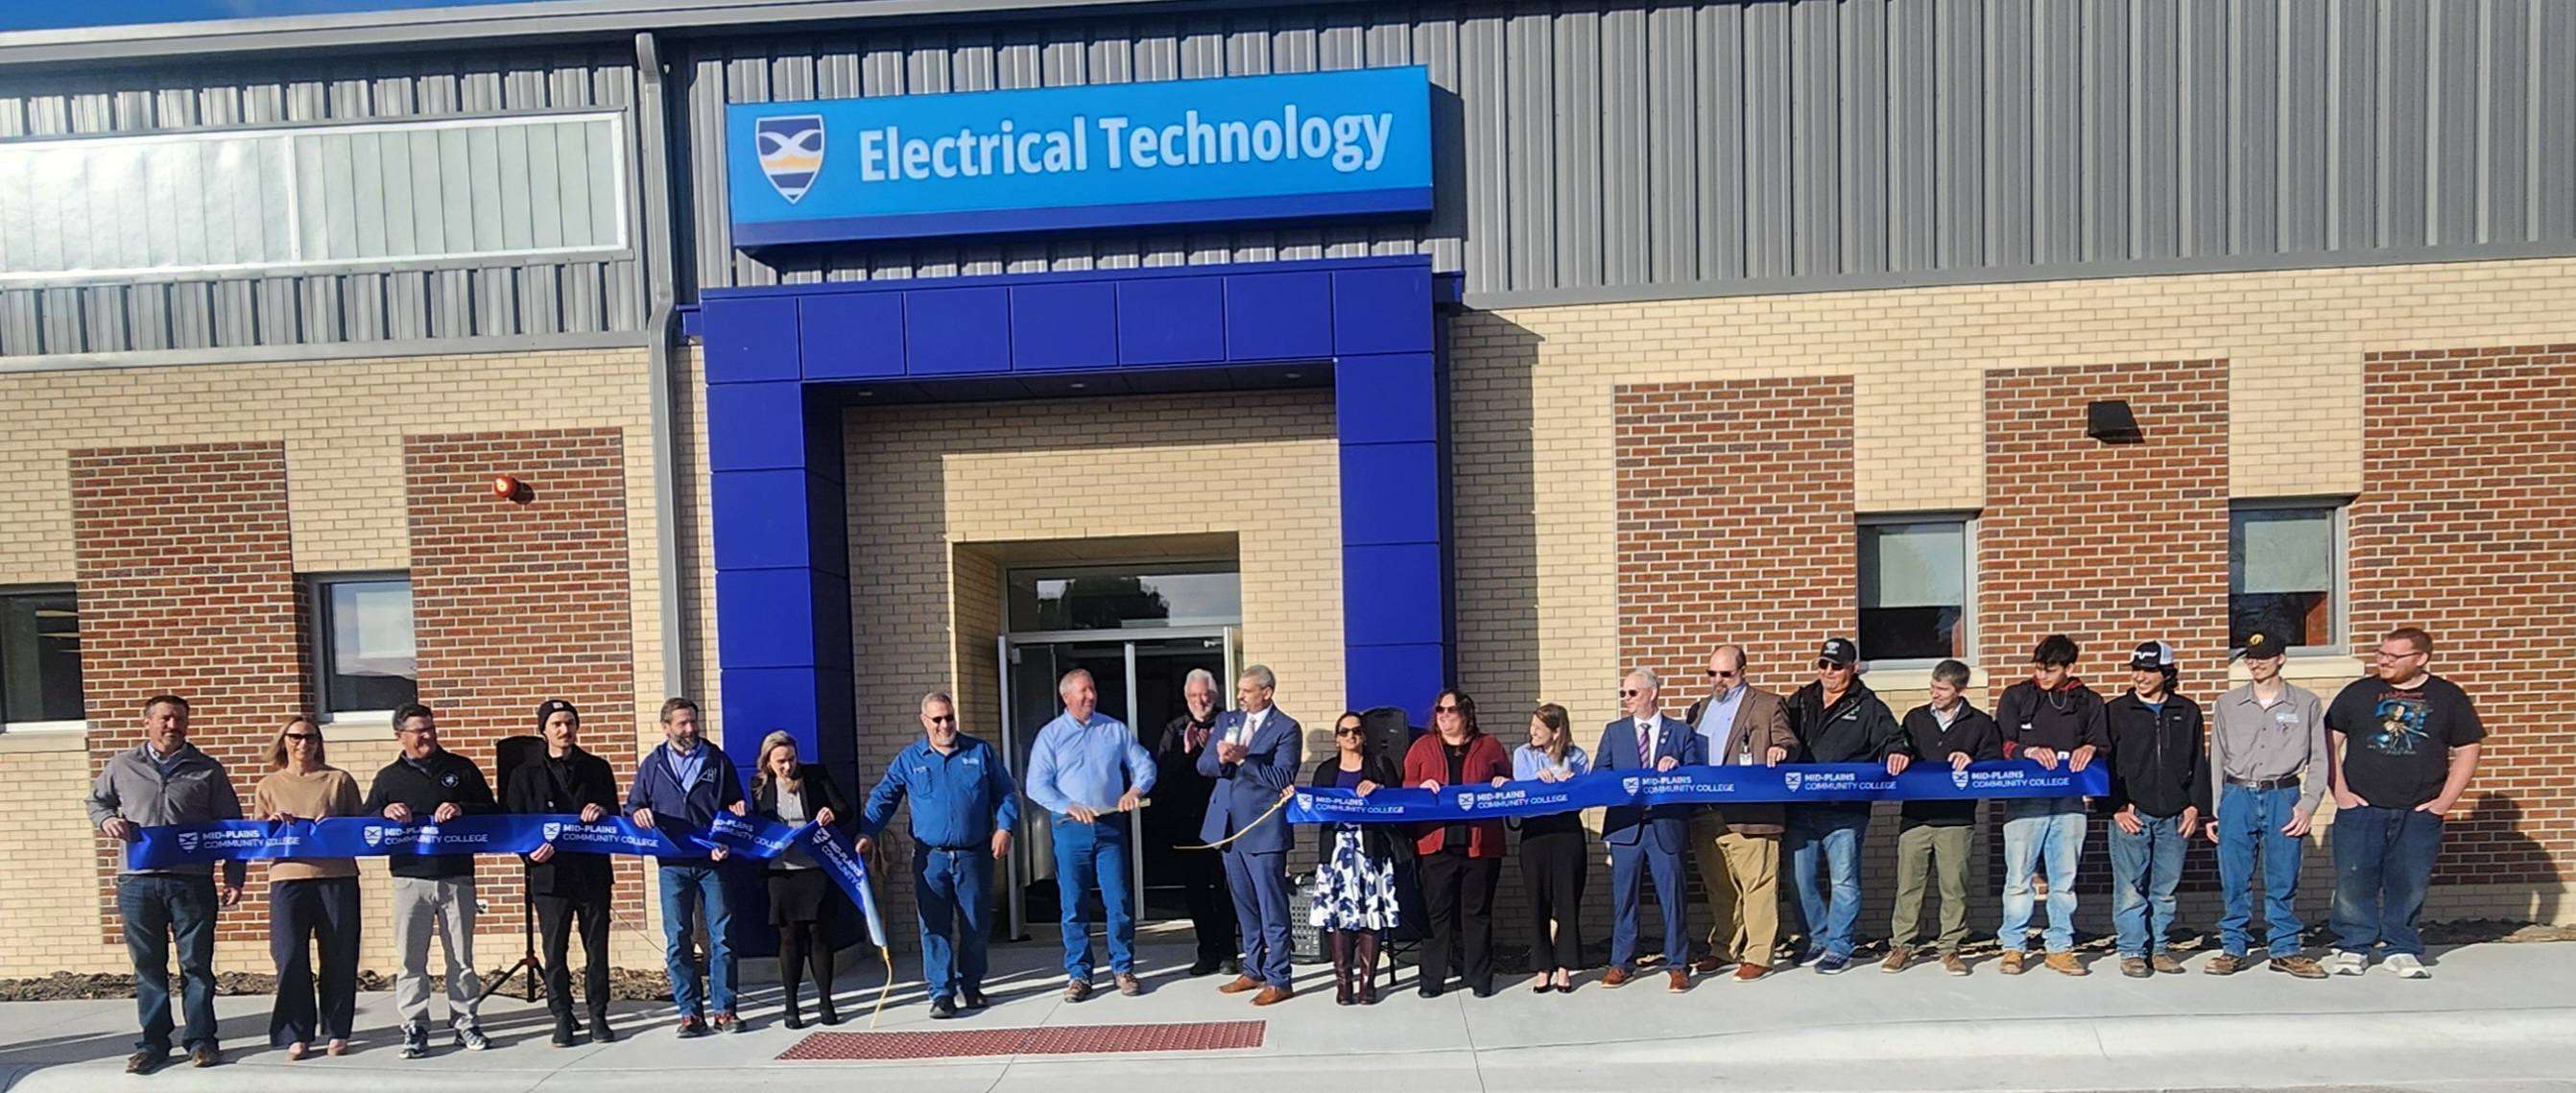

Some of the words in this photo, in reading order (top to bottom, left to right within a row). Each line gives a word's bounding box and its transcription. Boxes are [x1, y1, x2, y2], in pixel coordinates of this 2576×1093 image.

[860, 116, 1085, 182] Electrical
[1099, 104, 1394, 172] Technology
[1971, 771, 2024, 779] MID-PLAINS
[1642, 776, 1692, 785] MID-PLAINS
[1972, 779, 2027, 788] COMMUNITY
[2029, 777, 2070, 786] COLLEGE
[1643, 785, 1696, 794] COMMUNITY
[1804, 782, 1858, 791] COMMUNITY
[1478, 791, 1525, 800] MID-PLAINS
[1478, 798, 1529, 809] COMMUNITY
[1530, 795, 1568, 804] COLLEGE
[1316, 804, 1367, 813] COMMUNITY
[563, 824, 617, 834] MID-PLAINS
[203, 830, 260, 840] MID-PLAINS
[443, 834, 489, 843] COLLEGE
[203, 839, 264, 848] COMMUNITY
[563, 834, 620, 843] COMMUNITY
[620, 836, 658, 847] COLLEGE
[828, 840, 864, 877] MID-PLAINS
